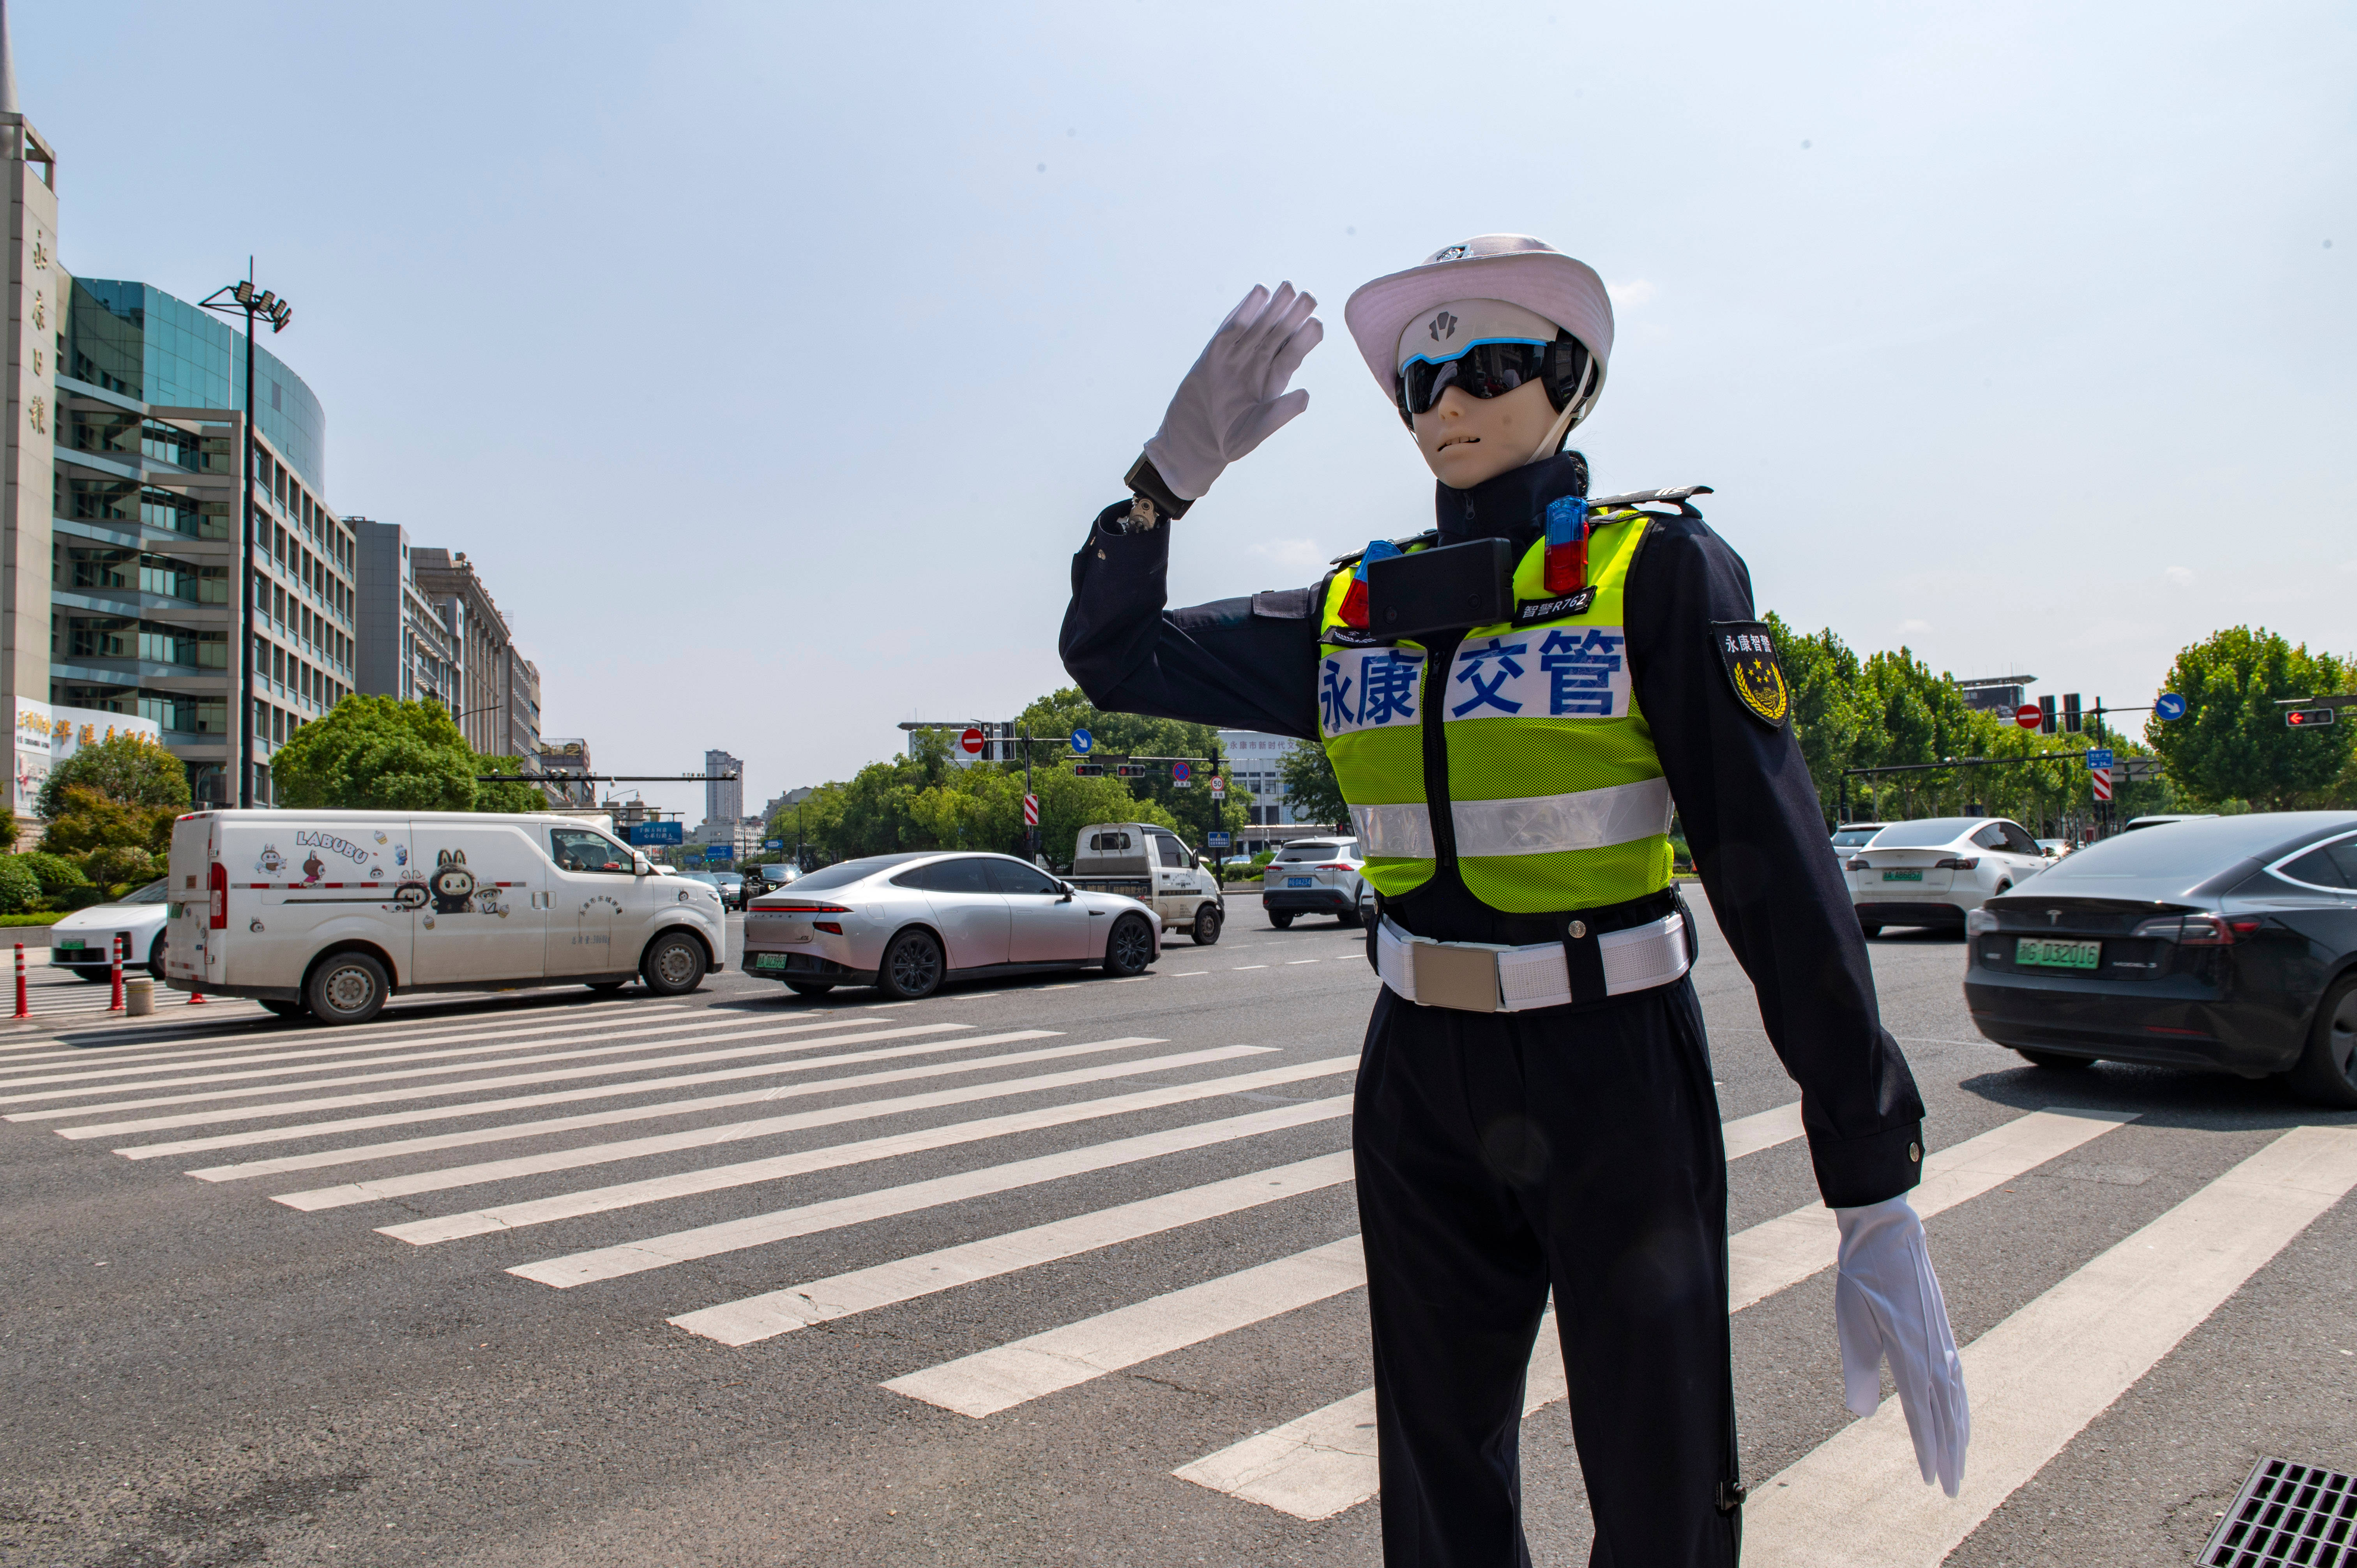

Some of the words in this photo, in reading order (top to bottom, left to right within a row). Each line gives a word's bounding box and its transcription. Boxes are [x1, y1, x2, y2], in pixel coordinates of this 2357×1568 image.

[1522, 593, 1587, 618] 智警R762
[1725, 634, 1772, 653] 永康智警
[1320, 649, 1424, 733] 永康
[1452, 629, 1624, 716] 交管
[1230, 741, 1294, 750] 永康市新时代文
[297, 831, 369, 864] LABUBU
[580, 895, 622, 916] 永康市东城街道
